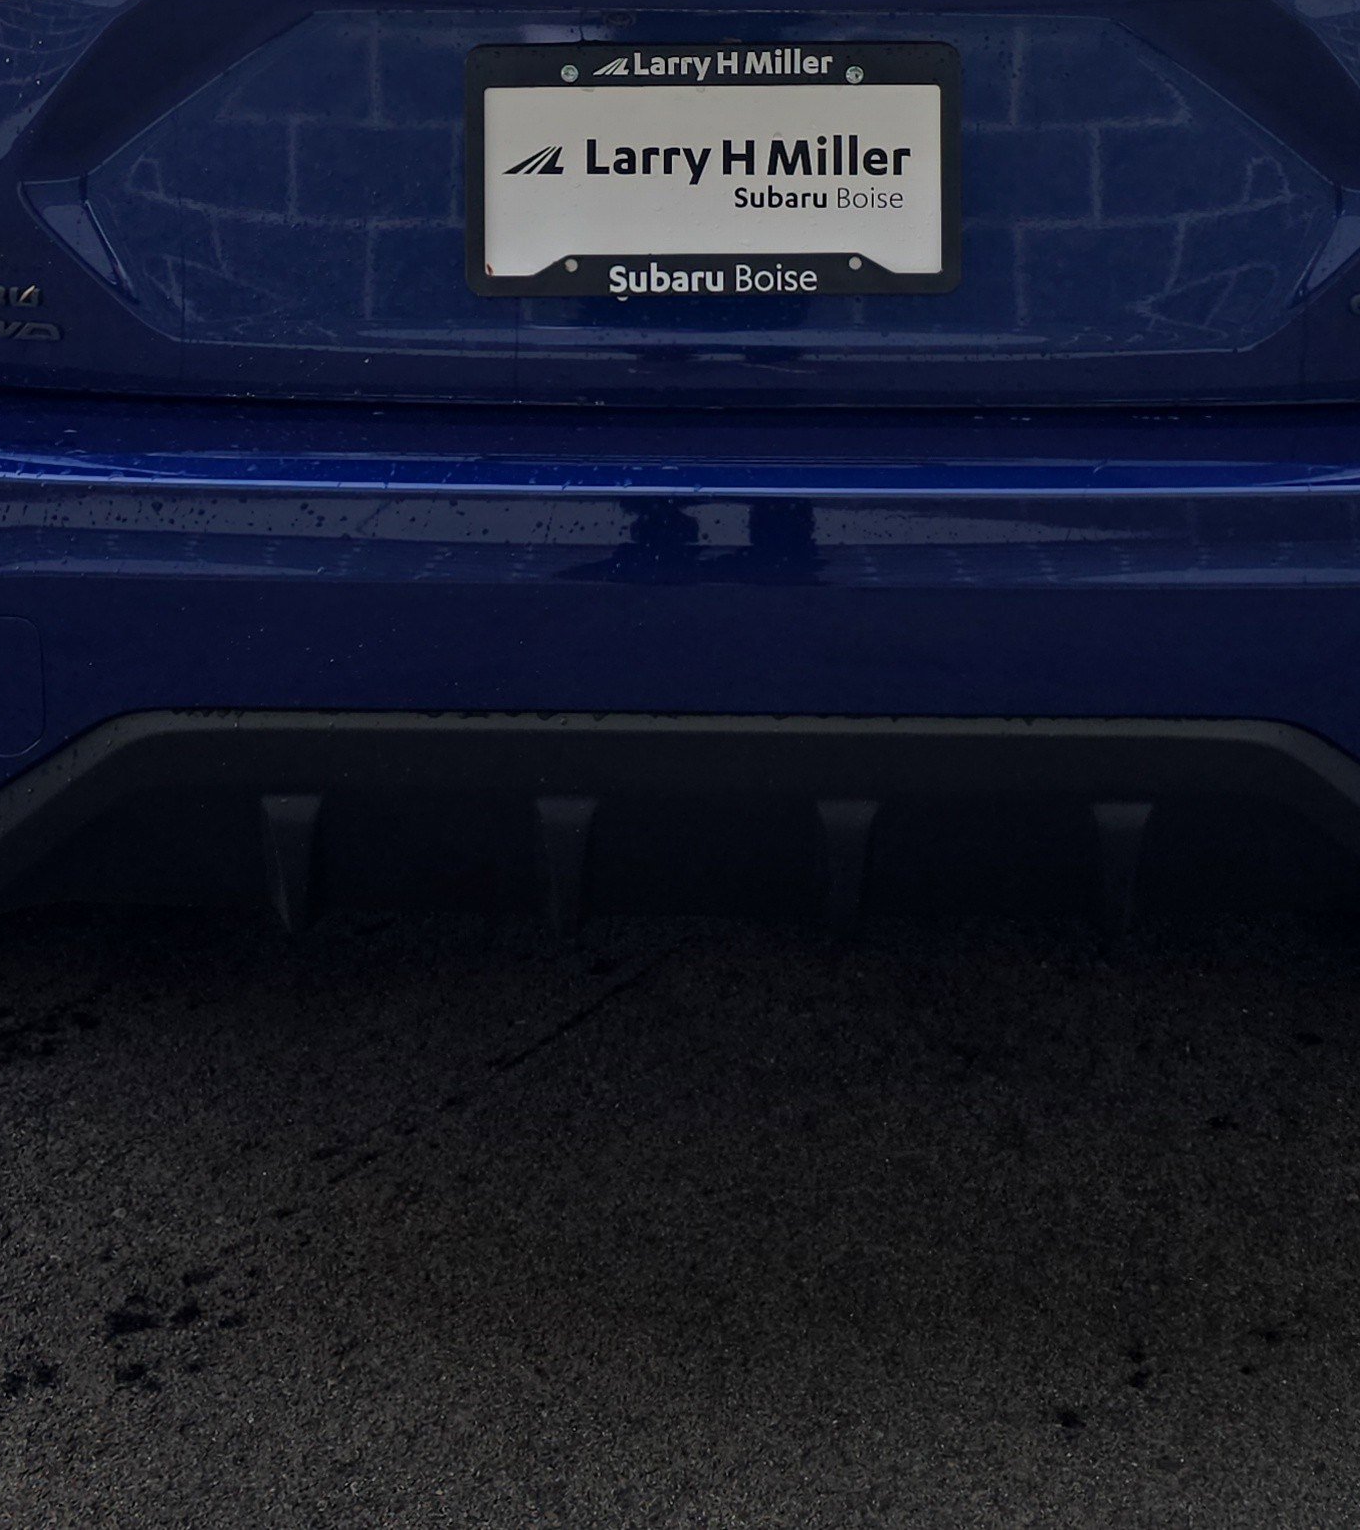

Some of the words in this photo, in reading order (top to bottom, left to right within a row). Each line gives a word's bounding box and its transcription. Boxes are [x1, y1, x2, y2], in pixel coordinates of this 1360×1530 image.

[634, 52, 712, 81] Larry
[718, 52, 739, 75] H
[744, 49, 834, 75] Miller
[586, 138, 712, 185] Larry
[723, 139, 755, 176] H
[767, 135, 911, 176] Miller
[734, 185, 827, 209] Subaru
[837, 186, 903, 209] Boise
[609, 263, 725, 294] Subaru
[735, 263, 818, 293] Boise
